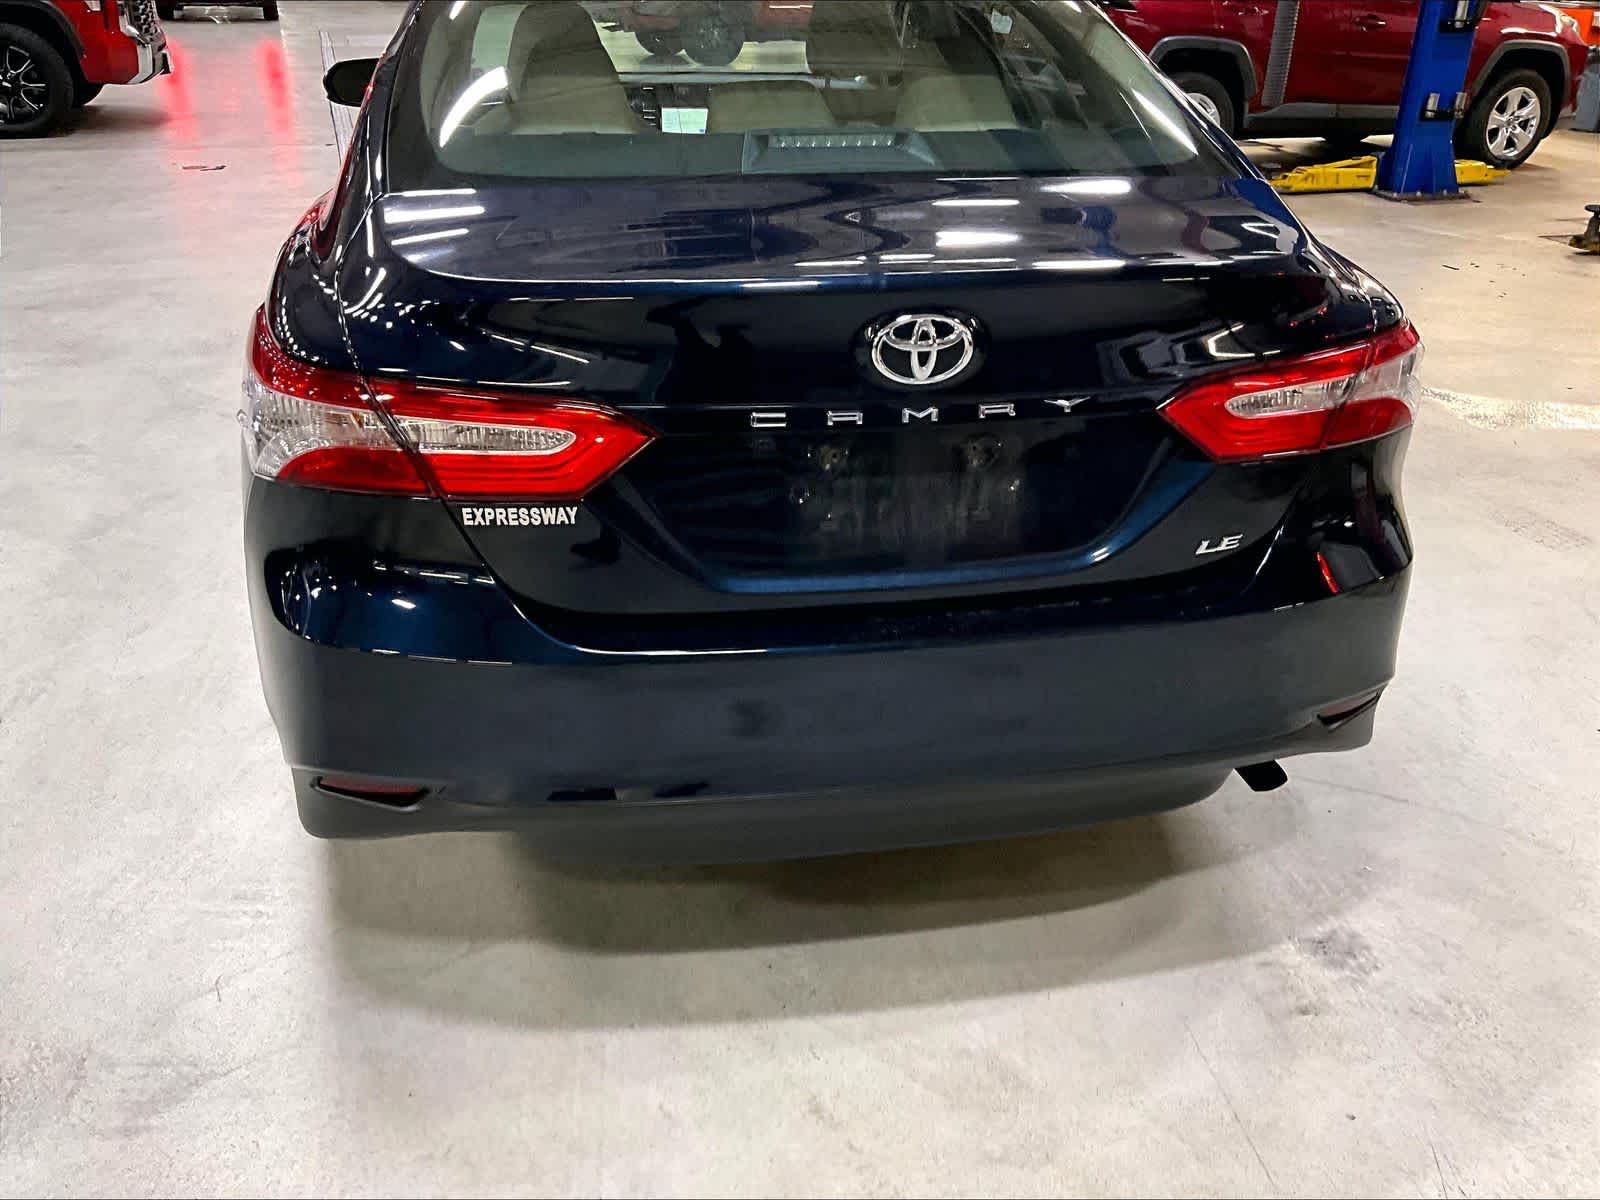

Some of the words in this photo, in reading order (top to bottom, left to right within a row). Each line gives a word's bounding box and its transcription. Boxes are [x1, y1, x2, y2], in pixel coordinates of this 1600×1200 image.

[750, 396, 1091, 427] CAMRY
[461, 506, 578, 526] EXPRESSWAY
[1195, 533, 1243, 555] LE
